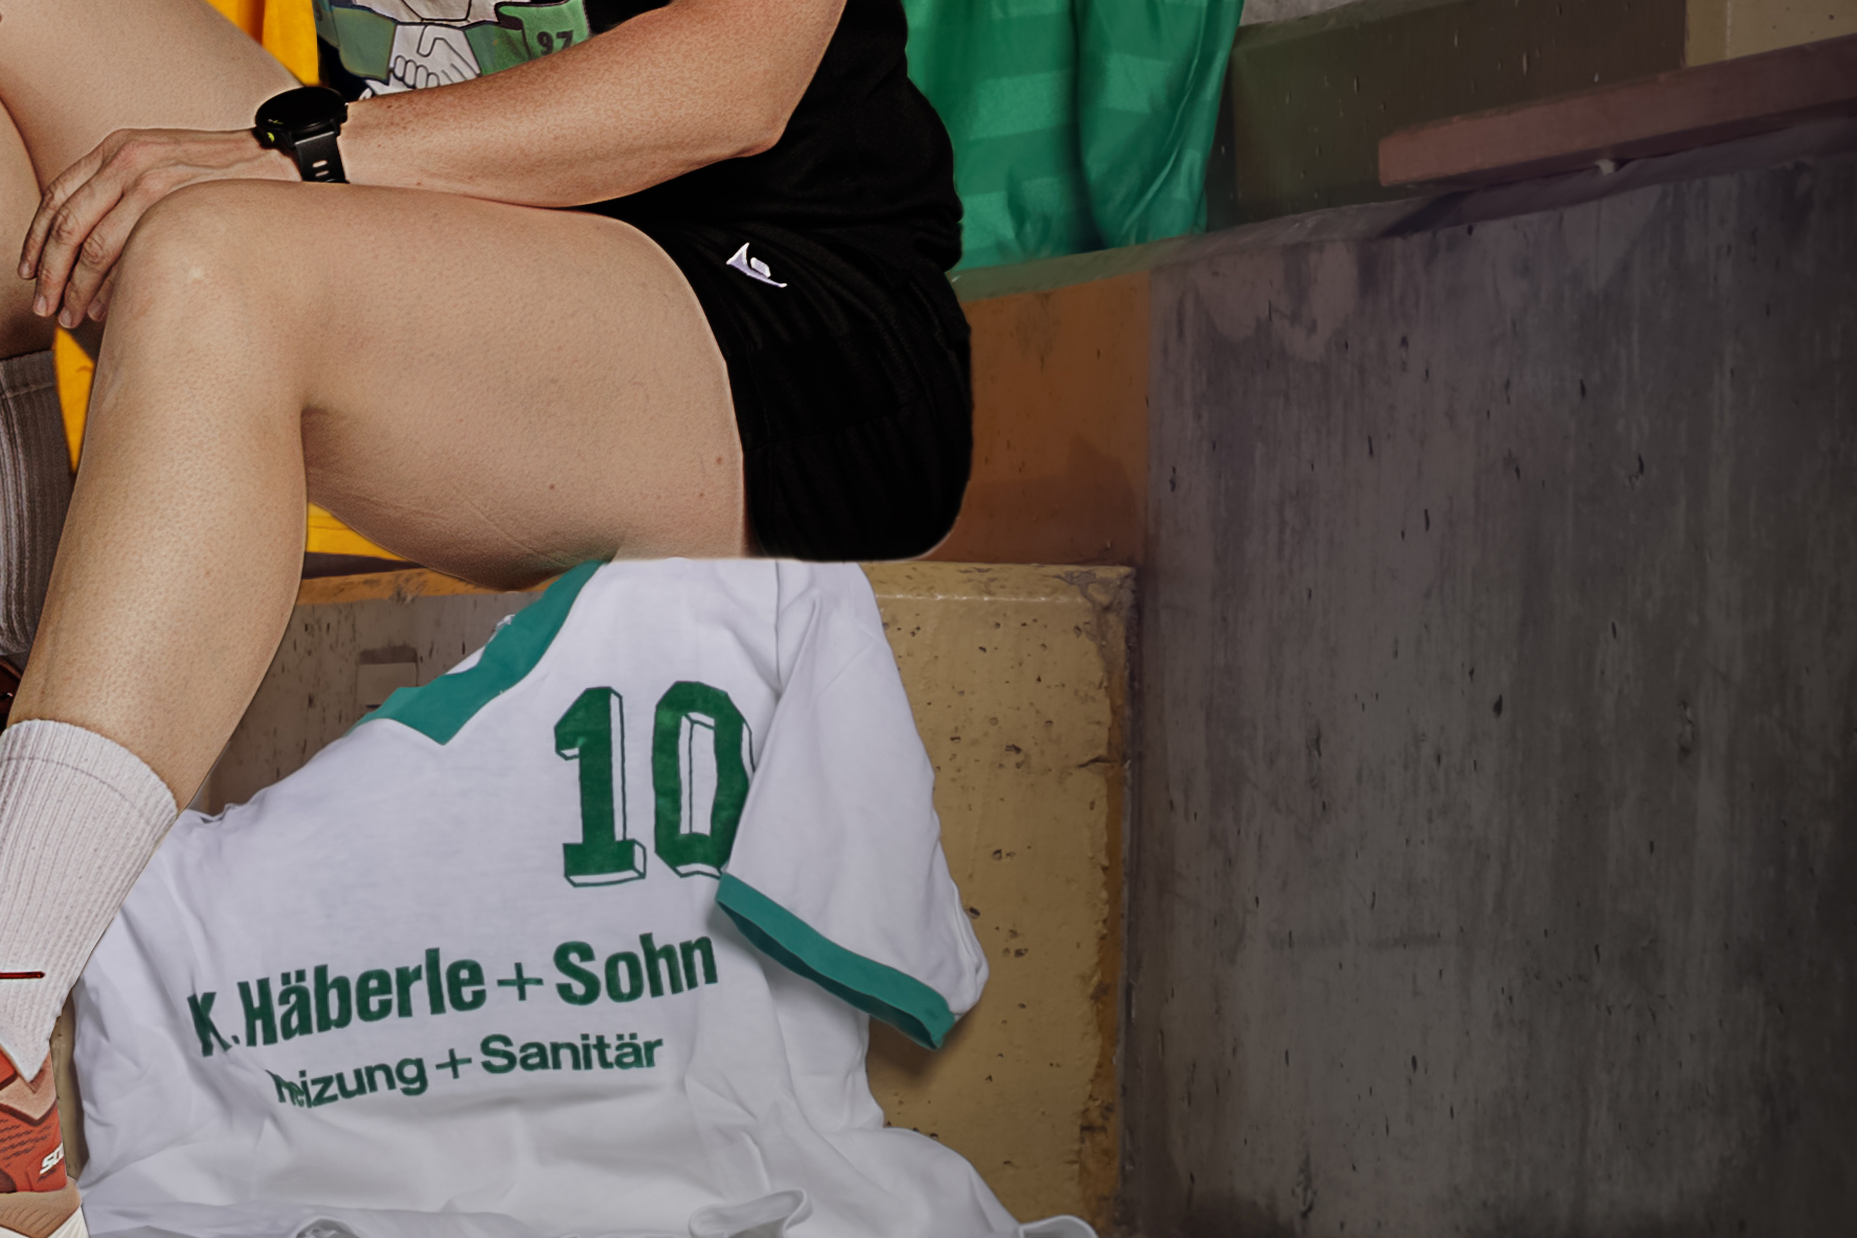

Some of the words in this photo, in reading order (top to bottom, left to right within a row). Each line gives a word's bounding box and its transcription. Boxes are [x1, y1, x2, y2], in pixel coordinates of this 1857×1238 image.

[554, 680, 756, 888] 10
[553, 932, 718, 1006] Sohn
[480, 1032, 664, 1074] Sanitär
